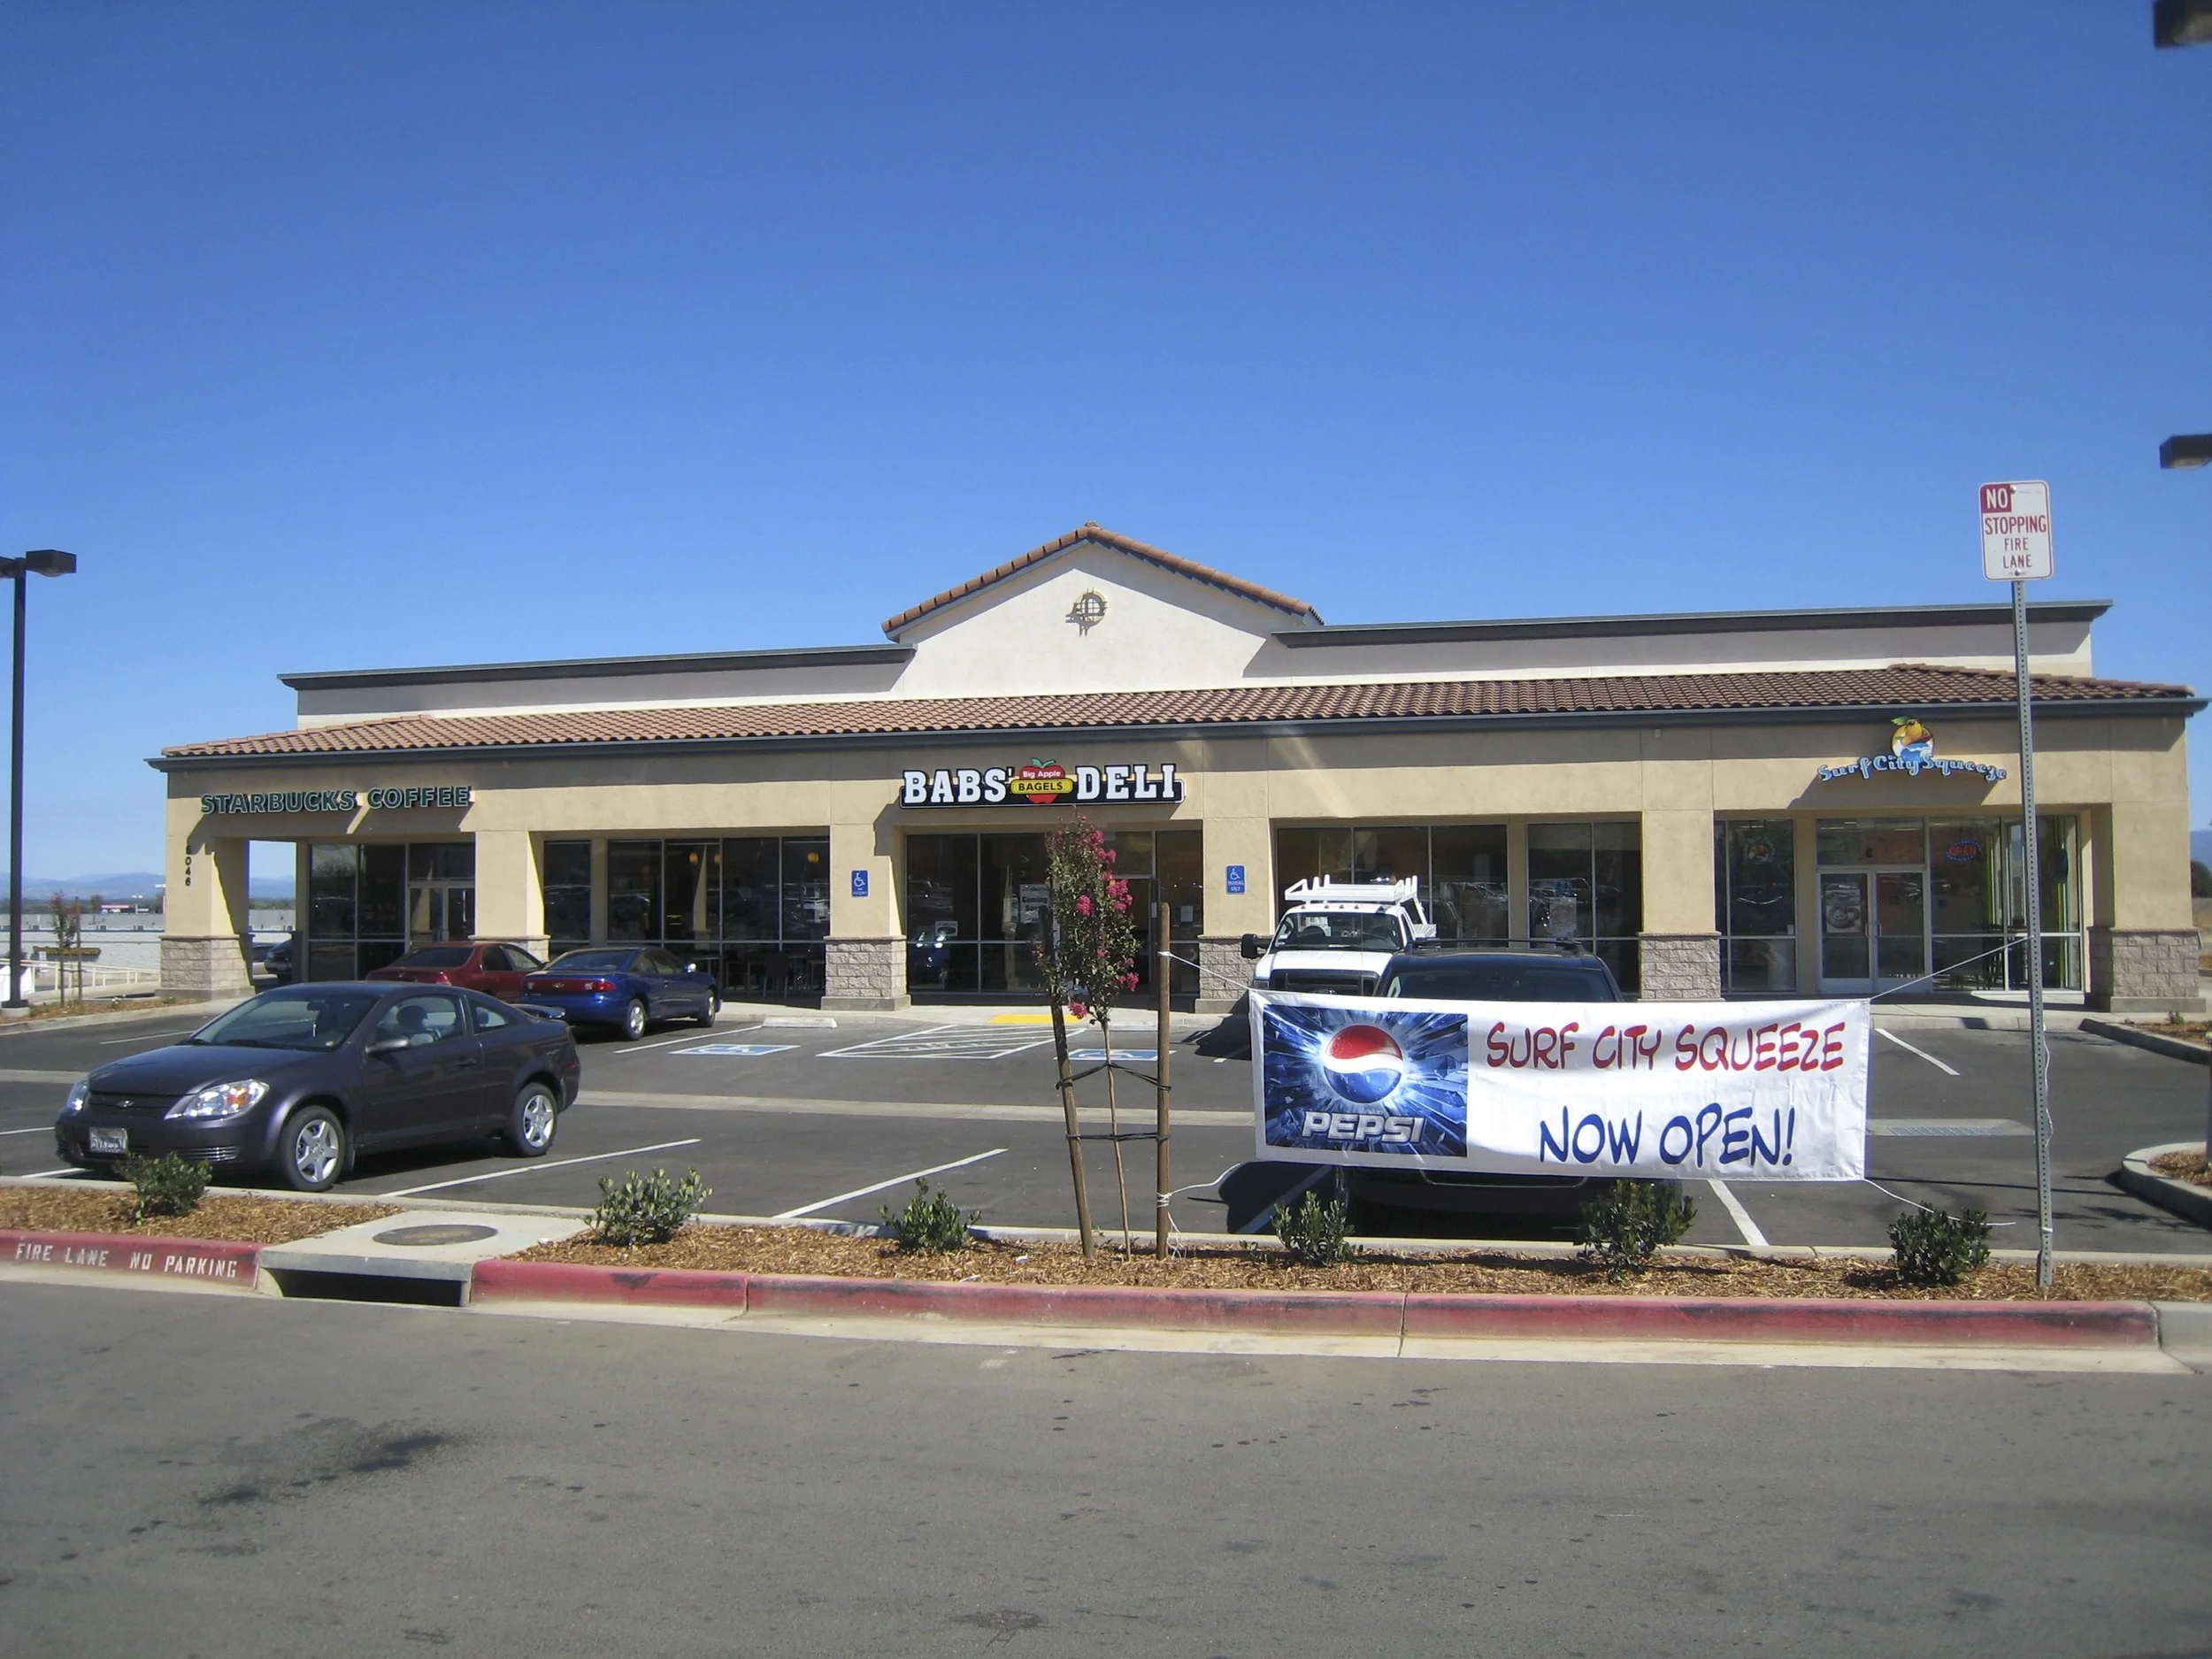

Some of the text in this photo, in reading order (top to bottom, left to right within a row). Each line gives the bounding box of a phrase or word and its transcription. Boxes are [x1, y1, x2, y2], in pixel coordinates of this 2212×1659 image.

[1985, 488, 2008, 509] NO
[1985, 515, 2047, 535] STOPPING
[2004, 537, 2029, 551] FIRE
[2003, 555, 2032, 569] LANE
[1818, 755, 2007, 781] Surf City Squeeze
[1018, 782, 1064, 791] BAGELS
[1076, 764, 1175, 800] DELI
[201, 786, 471, 814] STARBUCKS COFFEE
[1486, 1021, 1846, 1071] SURF CITY SQUEEZE
[1302, 1110, 1425, 1144] PEPSI
[1540, 1102, 1795, 1168] NOW OPEN!
[16, 1243, 238, 1279] FIRE LANE NO PARKING
